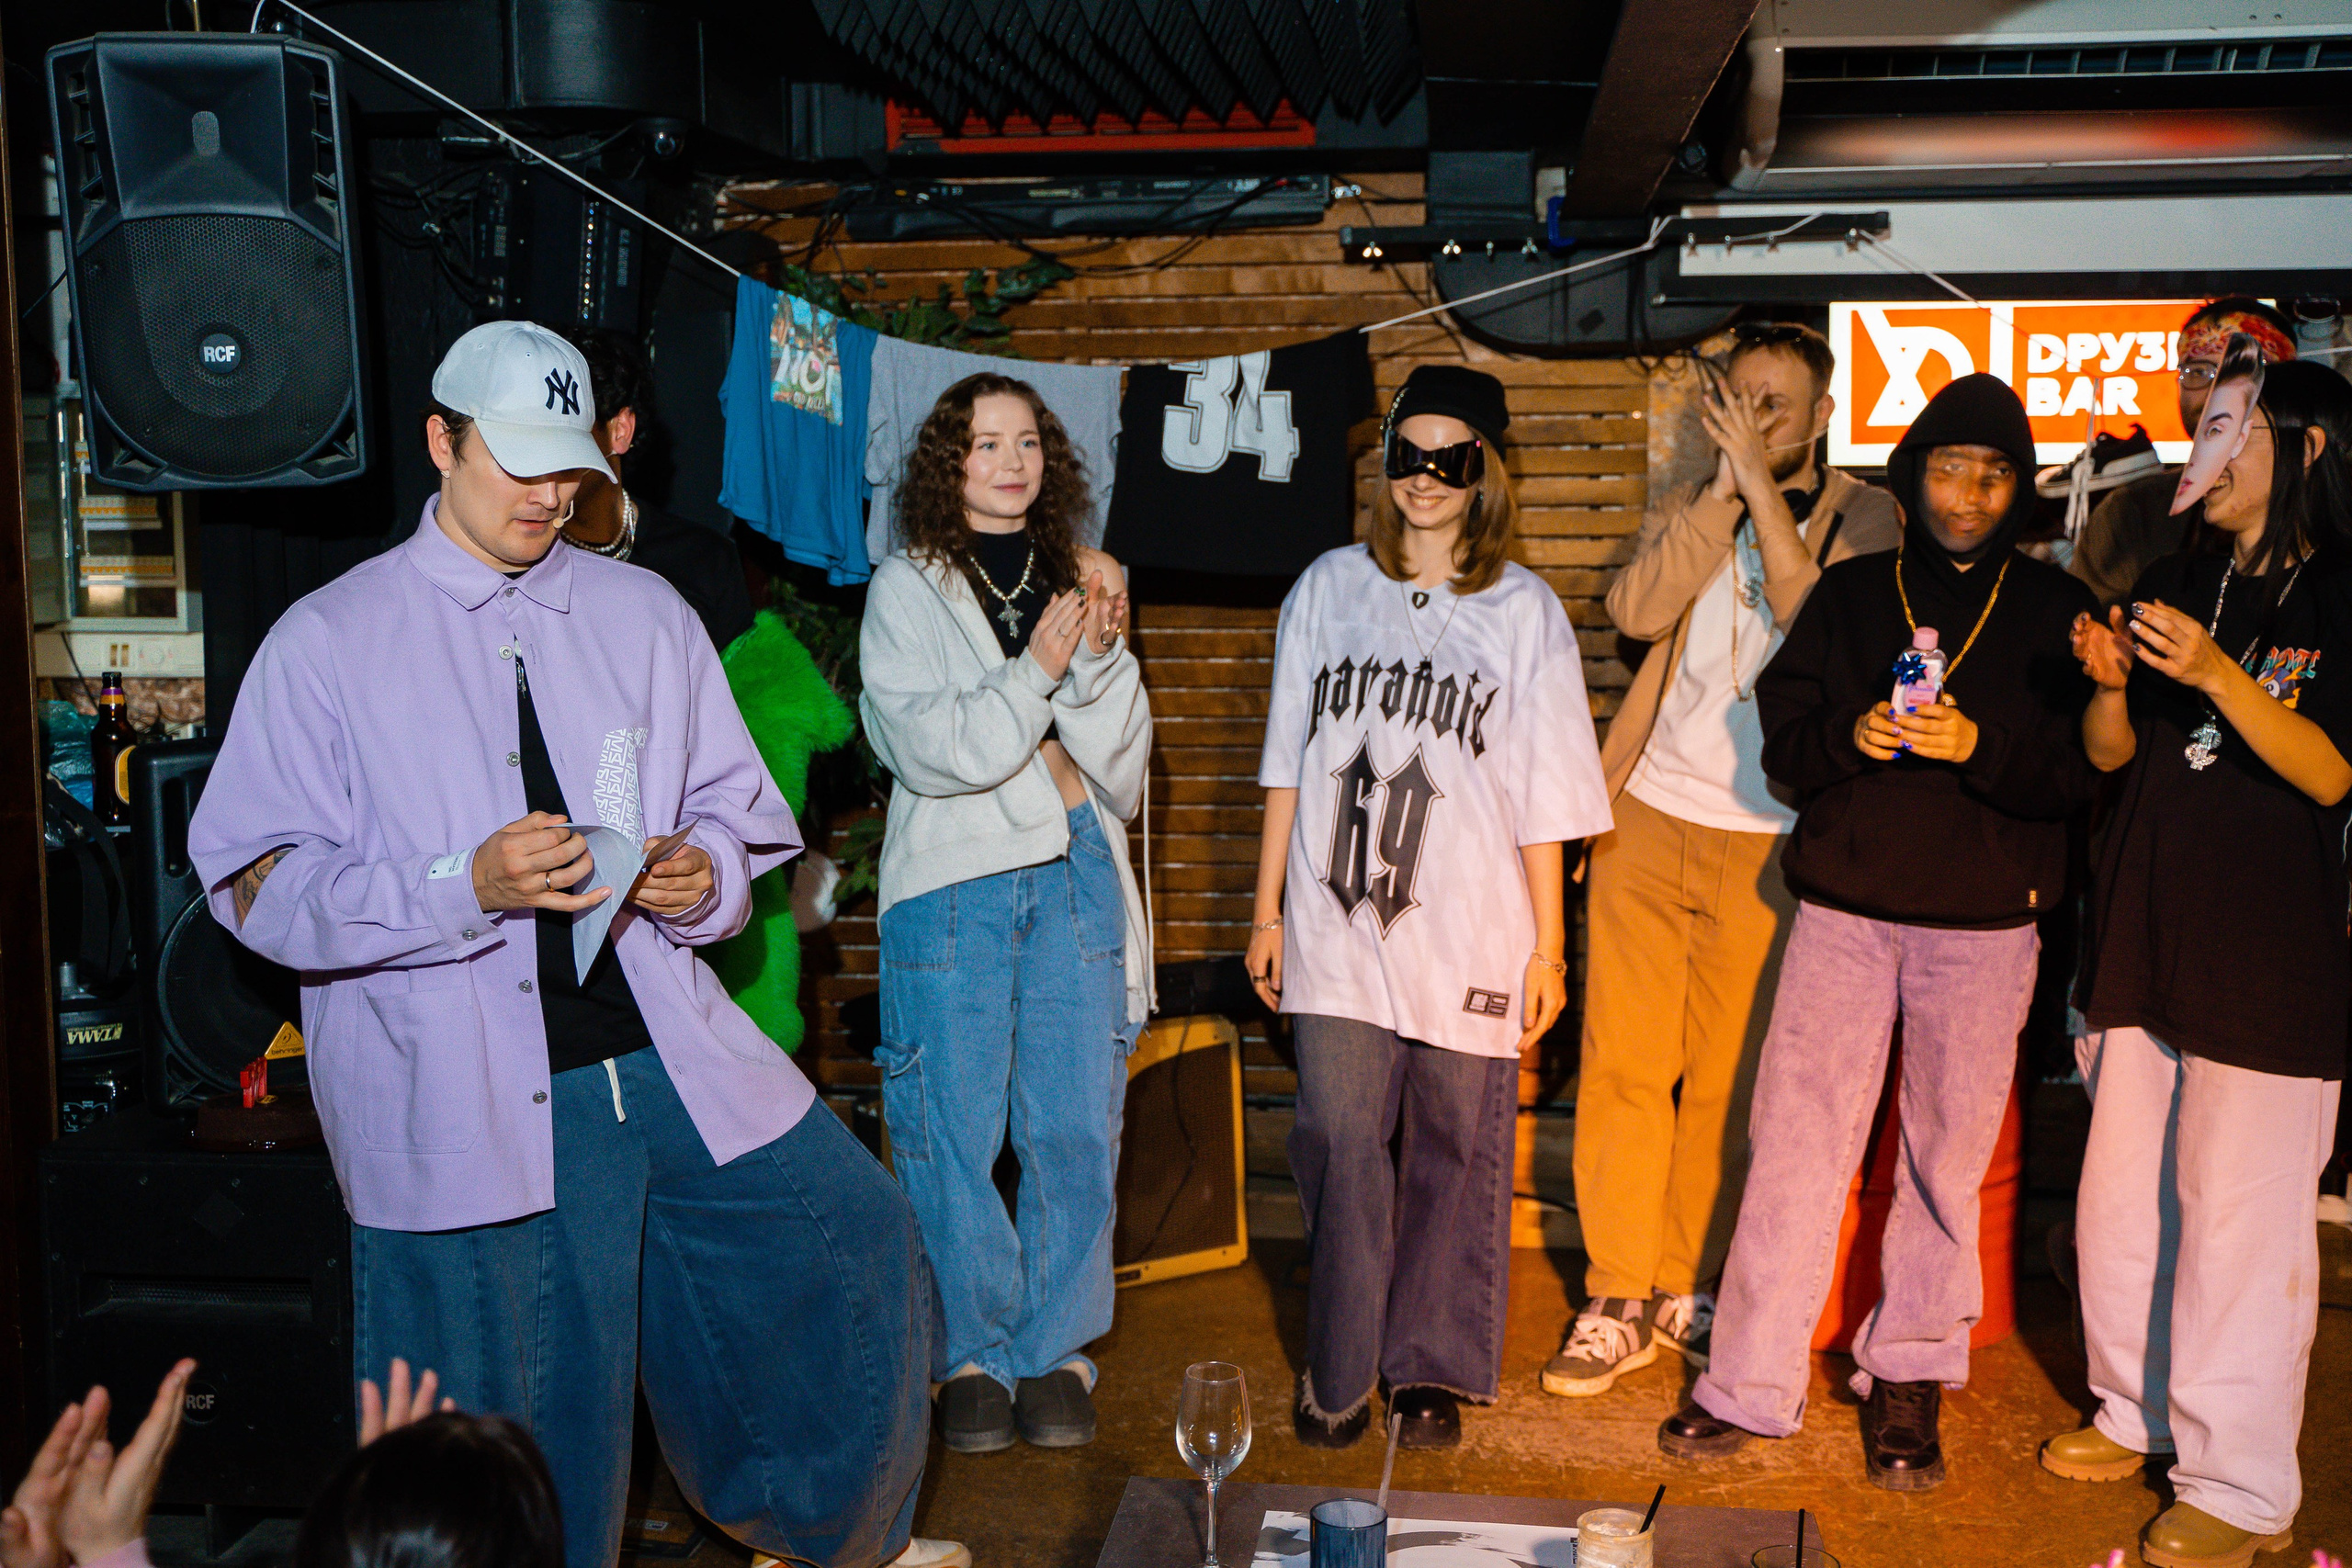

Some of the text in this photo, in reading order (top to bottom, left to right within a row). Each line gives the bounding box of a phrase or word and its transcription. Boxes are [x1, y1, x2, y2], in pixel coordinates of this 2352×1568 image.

[203, 345, 235, 363] RCF
[544, 367, 581, 416] NY
[2026, 375, 2143, 417] BAR
[1161, 349, 1300, 483] 34
[1318, 730, 1445, 941] 69
[66, 1028, 112, 1045] TAMA
[186, 1393, 215, 1410] RCF
